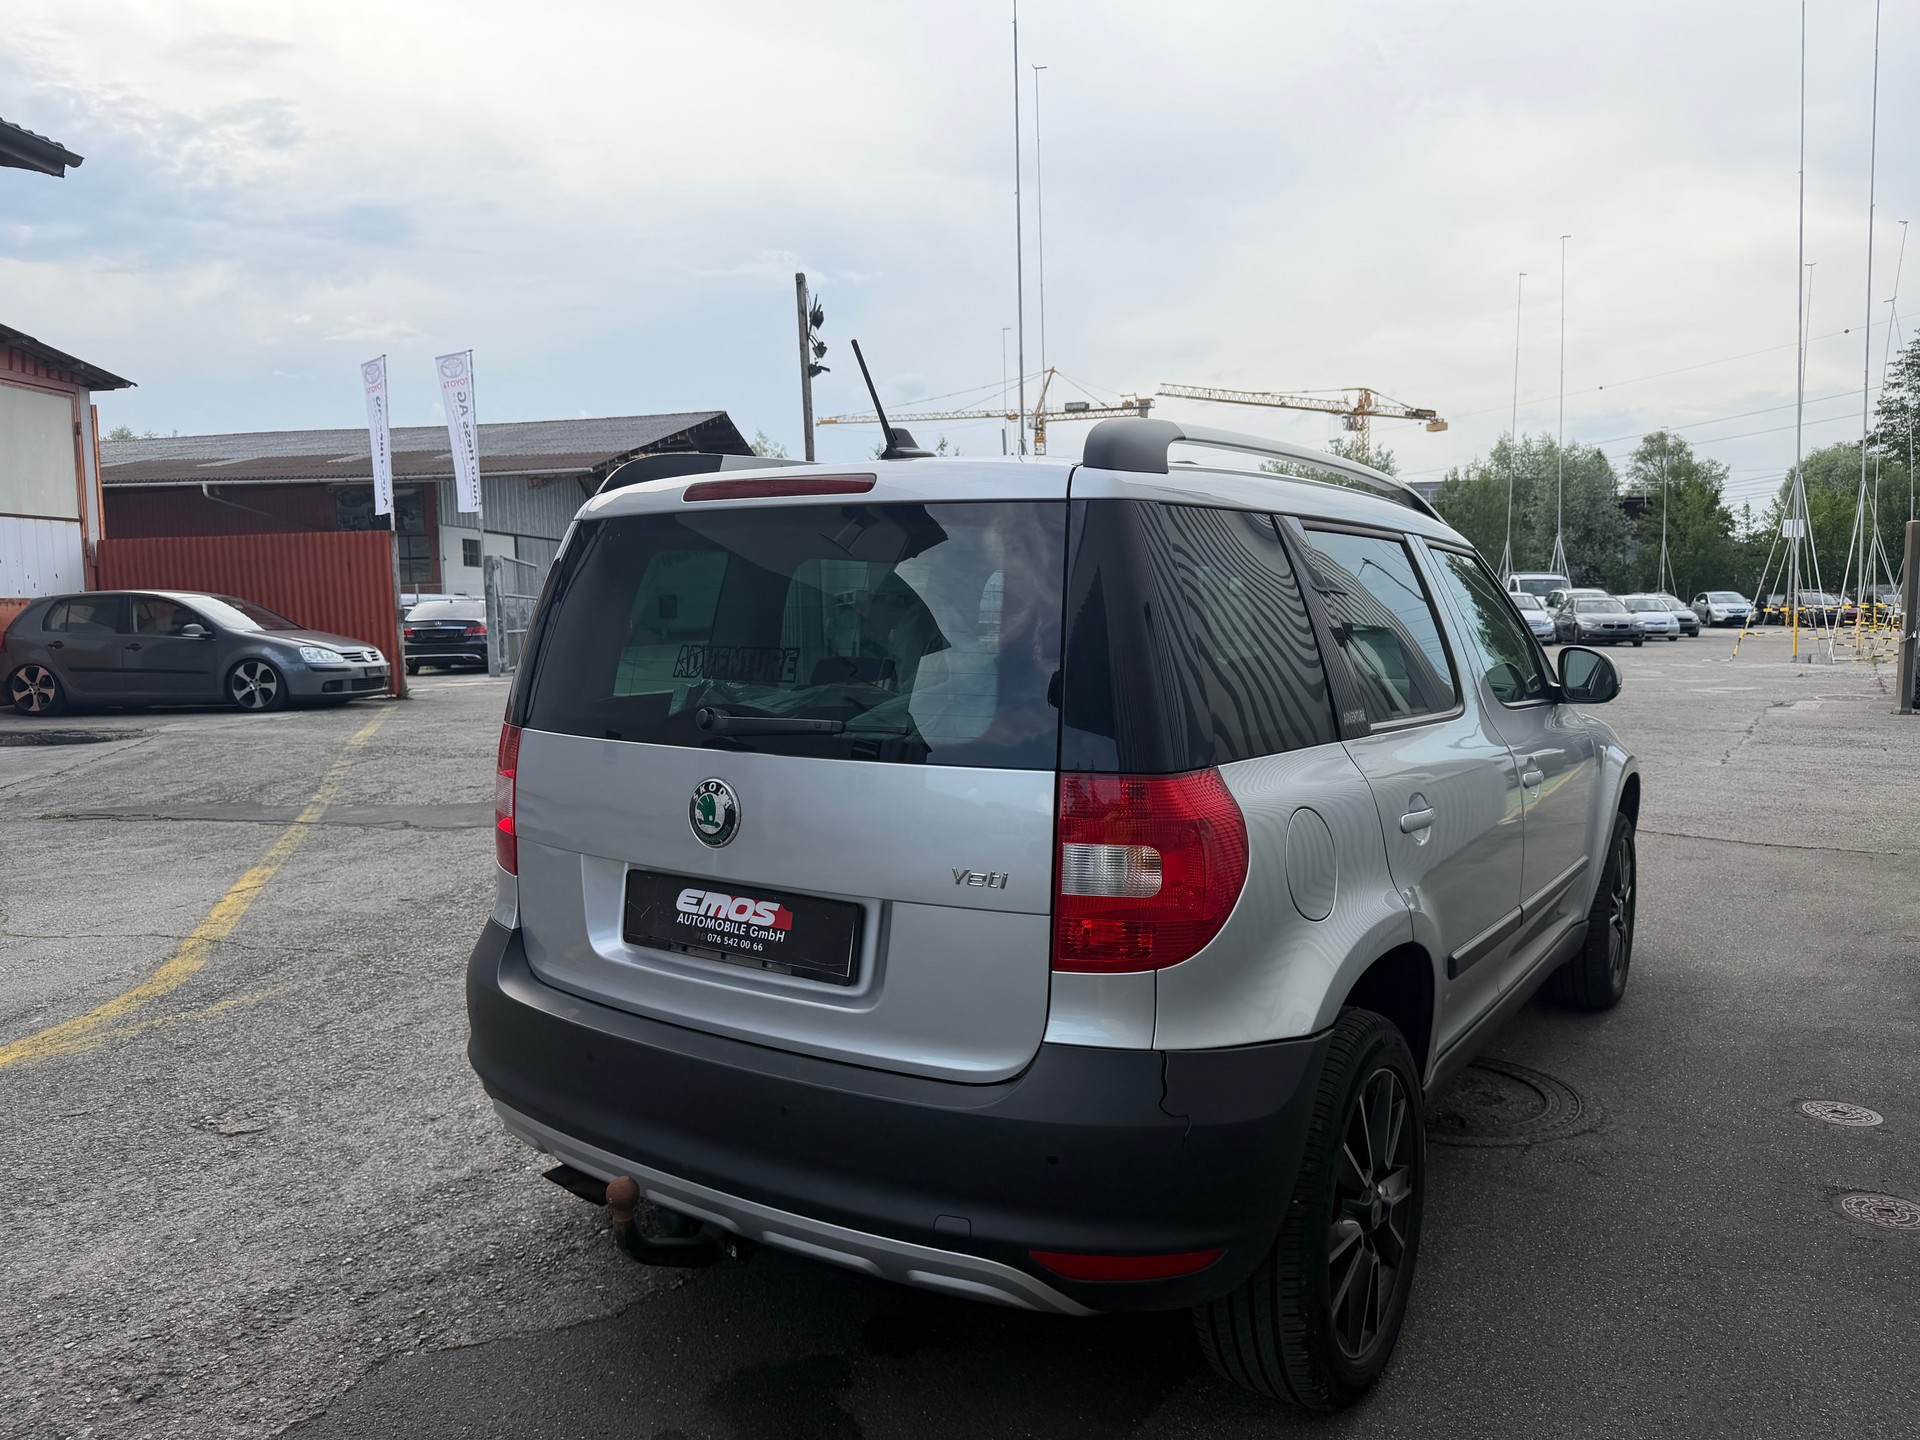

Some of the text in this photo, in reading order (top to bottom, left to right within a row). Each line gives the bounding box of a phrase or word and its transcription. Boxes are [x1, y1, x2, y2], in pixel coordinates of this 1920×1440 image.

[672, 644, 801, 683] ADVENTURE
[951, 866, 1009, 890] Yeti
[675, 887, 781, 927] EMOS
[676, 912, 786, 942] AUTOMOBILE GmbH
[707, 933, 763, 952] 076 542 00 66
